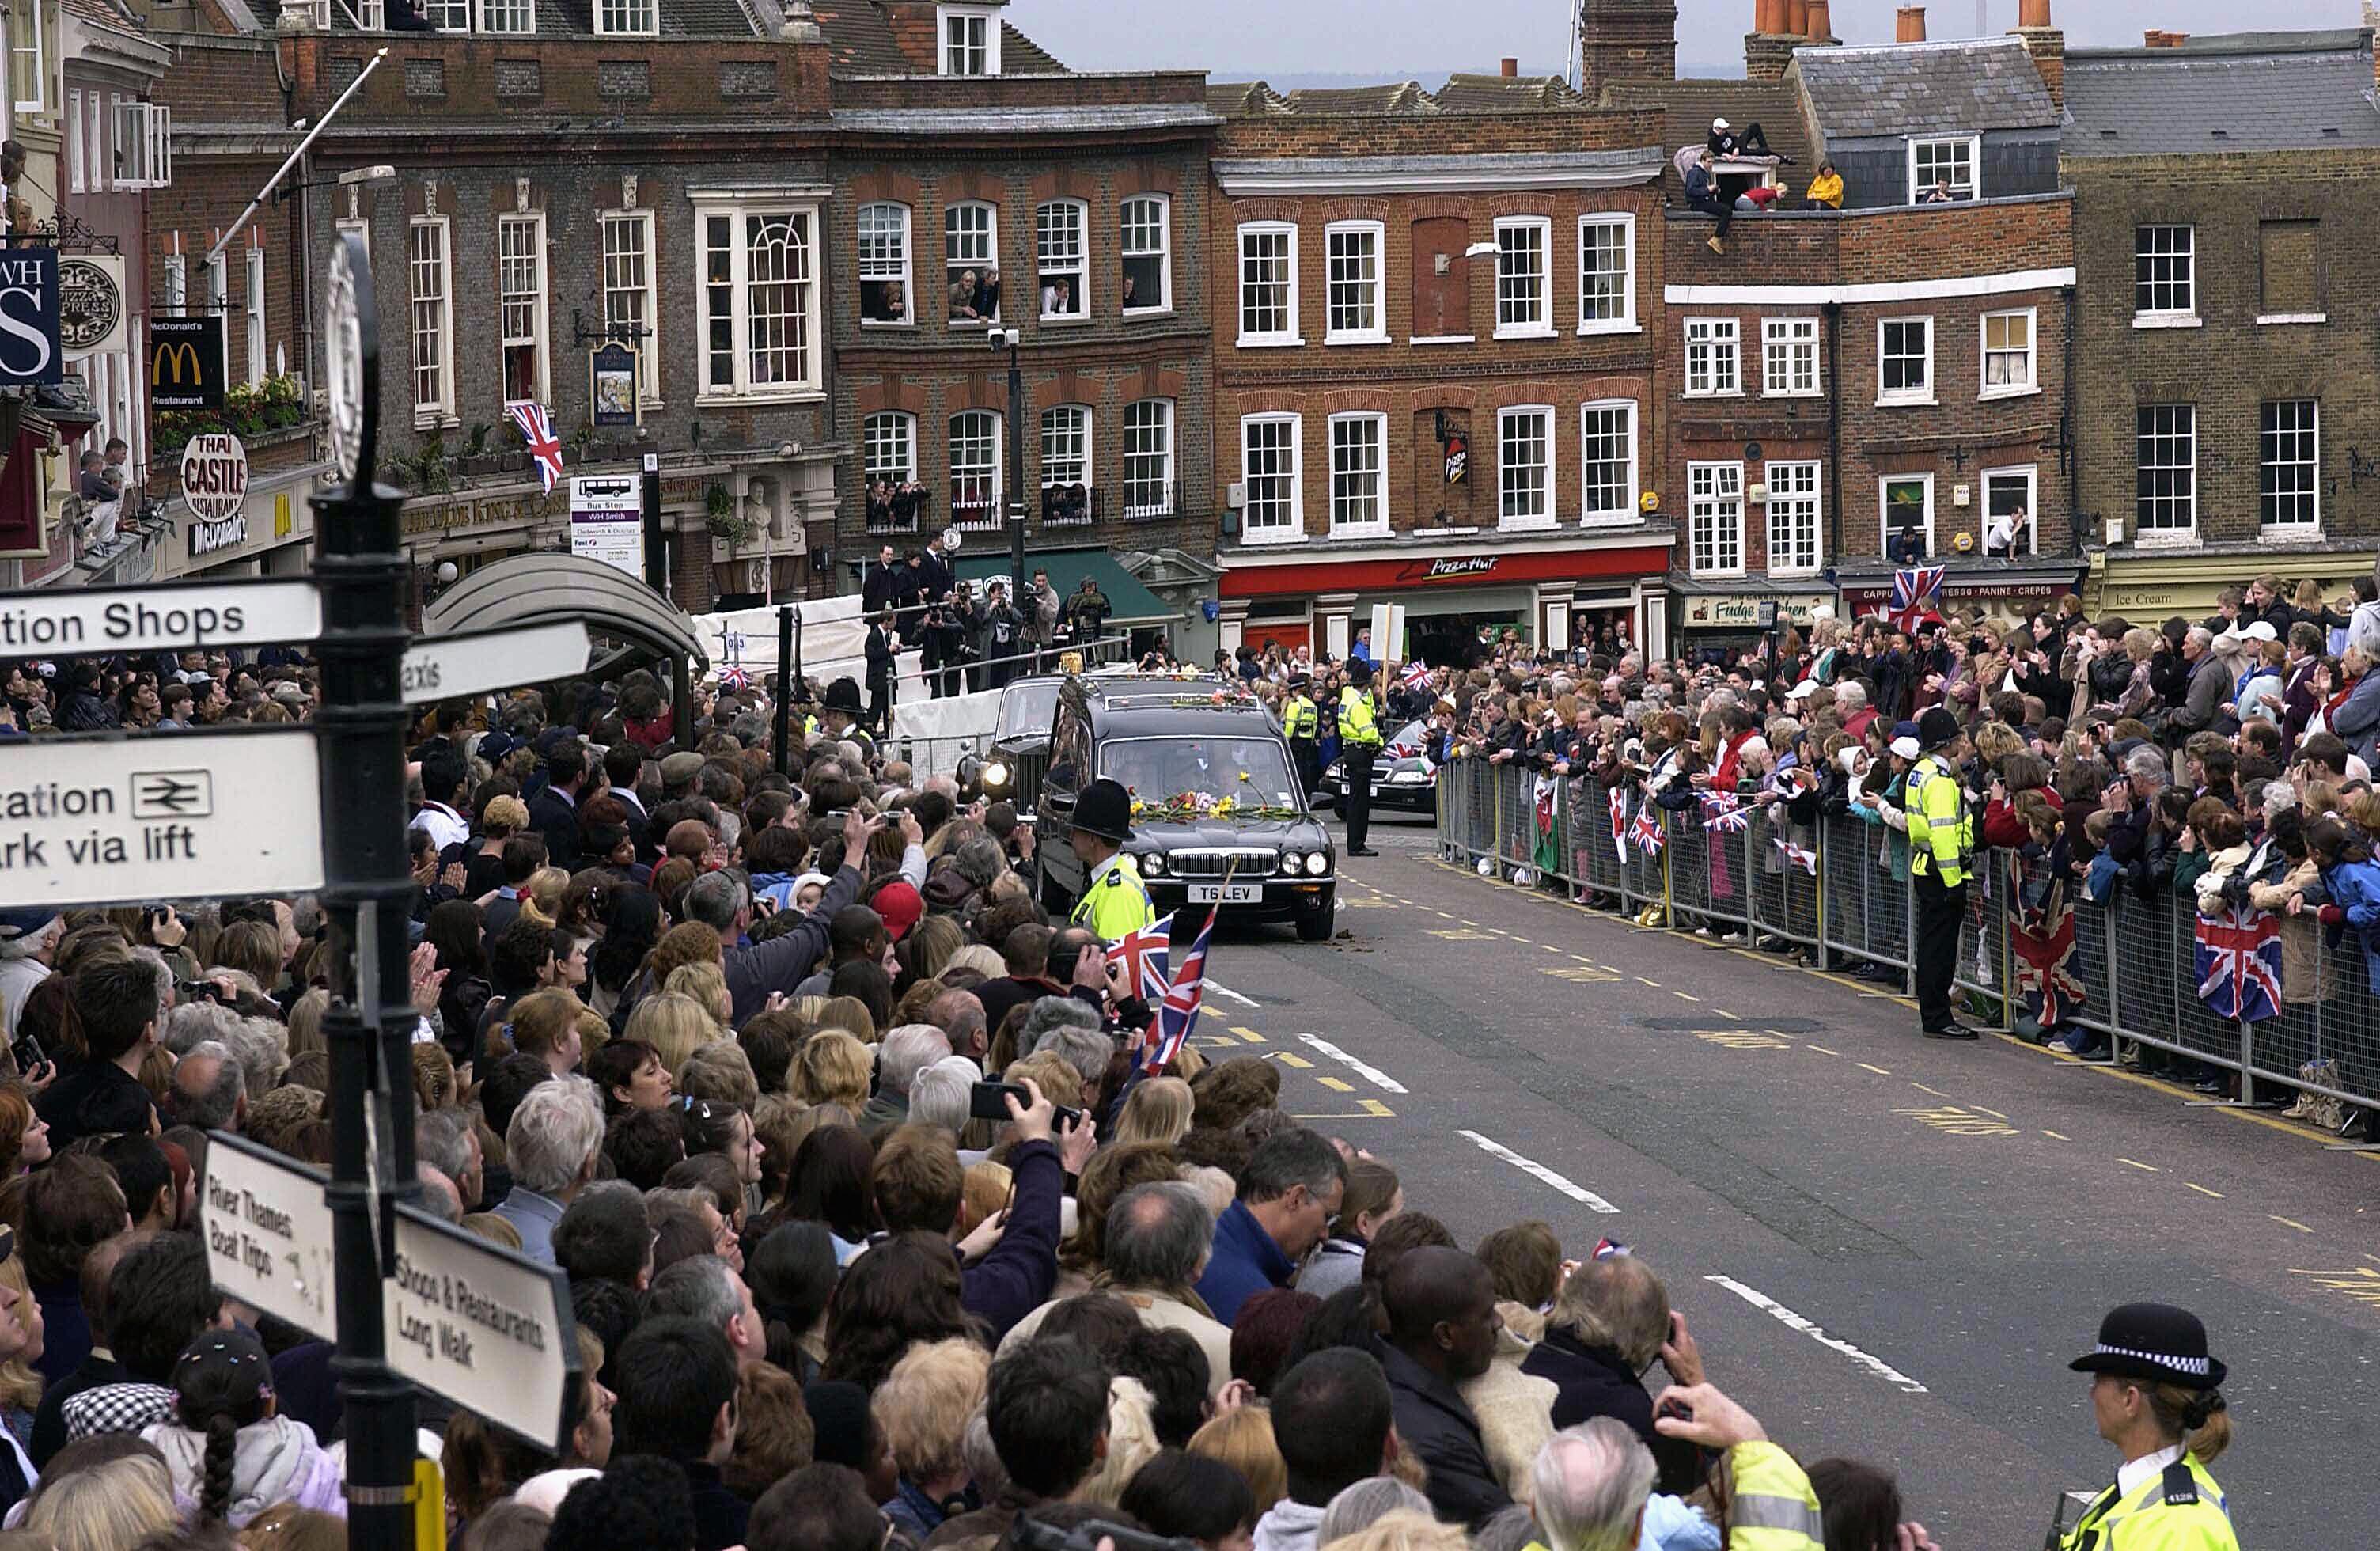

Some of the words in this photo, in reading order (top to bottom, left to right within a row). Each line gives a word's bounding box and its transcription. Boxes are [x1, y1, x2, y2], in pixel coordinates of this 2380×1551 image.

[61, 302, 110, 313] PRESS
[151, 322, 203, 331] McDonald's
[152, 396, 203, 405] Restaurant
[184, 457, 245, 495] CASTLE
[192, 497, 238, 518] RESTAURANT
[605, 502, 623, 510] Stop
[1431, 559, 1468, 575] Pizza
[1863, 590, 1893, 599] CAPPU
[1942, 588, 1972, 597] RESSO
[1979, 586, 2011, 596] PANINE
[2115, 594, 2132, 605] Ice
[2136, 593, 2172, 605] Cream
[1715, 601, 1755, 620] Fudge
[1778, 601, 1808, 616] chen
[3, 609, 84, 644] tion
[104, 601, 244, 646] Shops
[404, 655, 442, 691] axis
[0, 782, 117, 820] ation
[0, 832, 48, 869] rk
[66, 829, 129, 865] via
[143, 824, 196, 861] lift
[208, 1174, 240, 1215] River
[243, 1189, 294, 1241] Thames
[209, 1219, 240, 1262] Boat
[241, 1233, 273, 1280] Trips
[397, 1252, 441, 1306] Shops
[442, 1276, 455, 1313] &
[457, 1279, 546, 1352] Restaurants
[397, 1300, 434, 1359] Long
[440, 1325, 475, 1368] Walk
